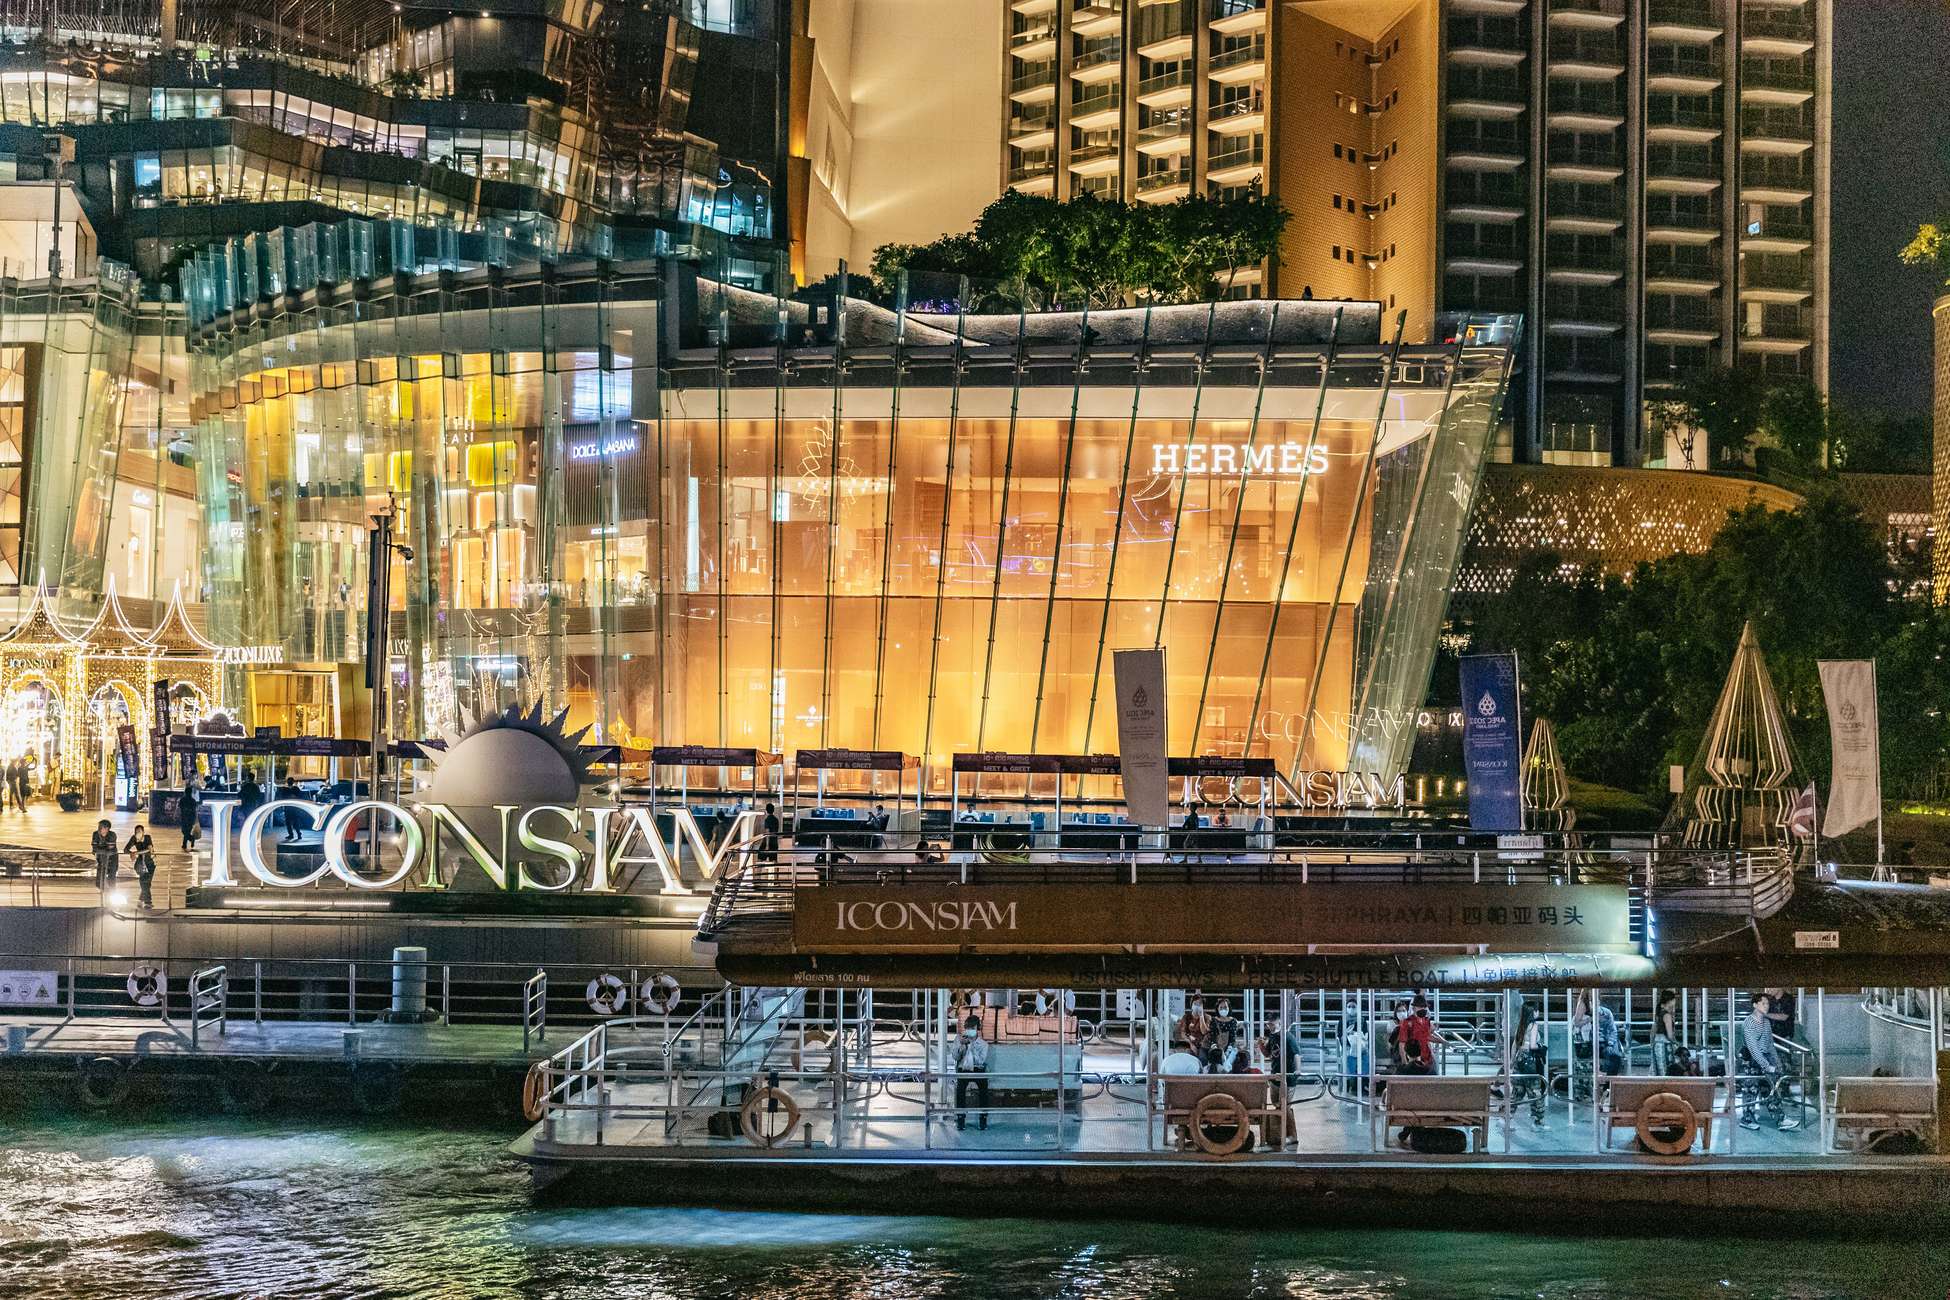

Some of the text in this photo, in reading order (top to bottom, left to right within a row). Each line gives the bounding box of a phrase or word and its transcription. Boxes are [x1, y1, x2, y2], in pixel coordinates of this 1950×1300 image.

[572, 443, 596, 458] DOLCE
[225, 645, 284, 664] ICONLUXE
[194, 740, 245, 750] INFORMATION
[201, 799, 766, 896] ICONSIAM
[835, 900, 1018, 932] ICONSIAM
[1345, 906, 1438, 925] PHRAYA
[1462, 905, 1584, 926] 四帕亚码头
[837, 973, 854, 983] 100
[856, 973, 870, 983] คน
[1248, 969, 1450, 985] FREE SHUTTLE BOAT
